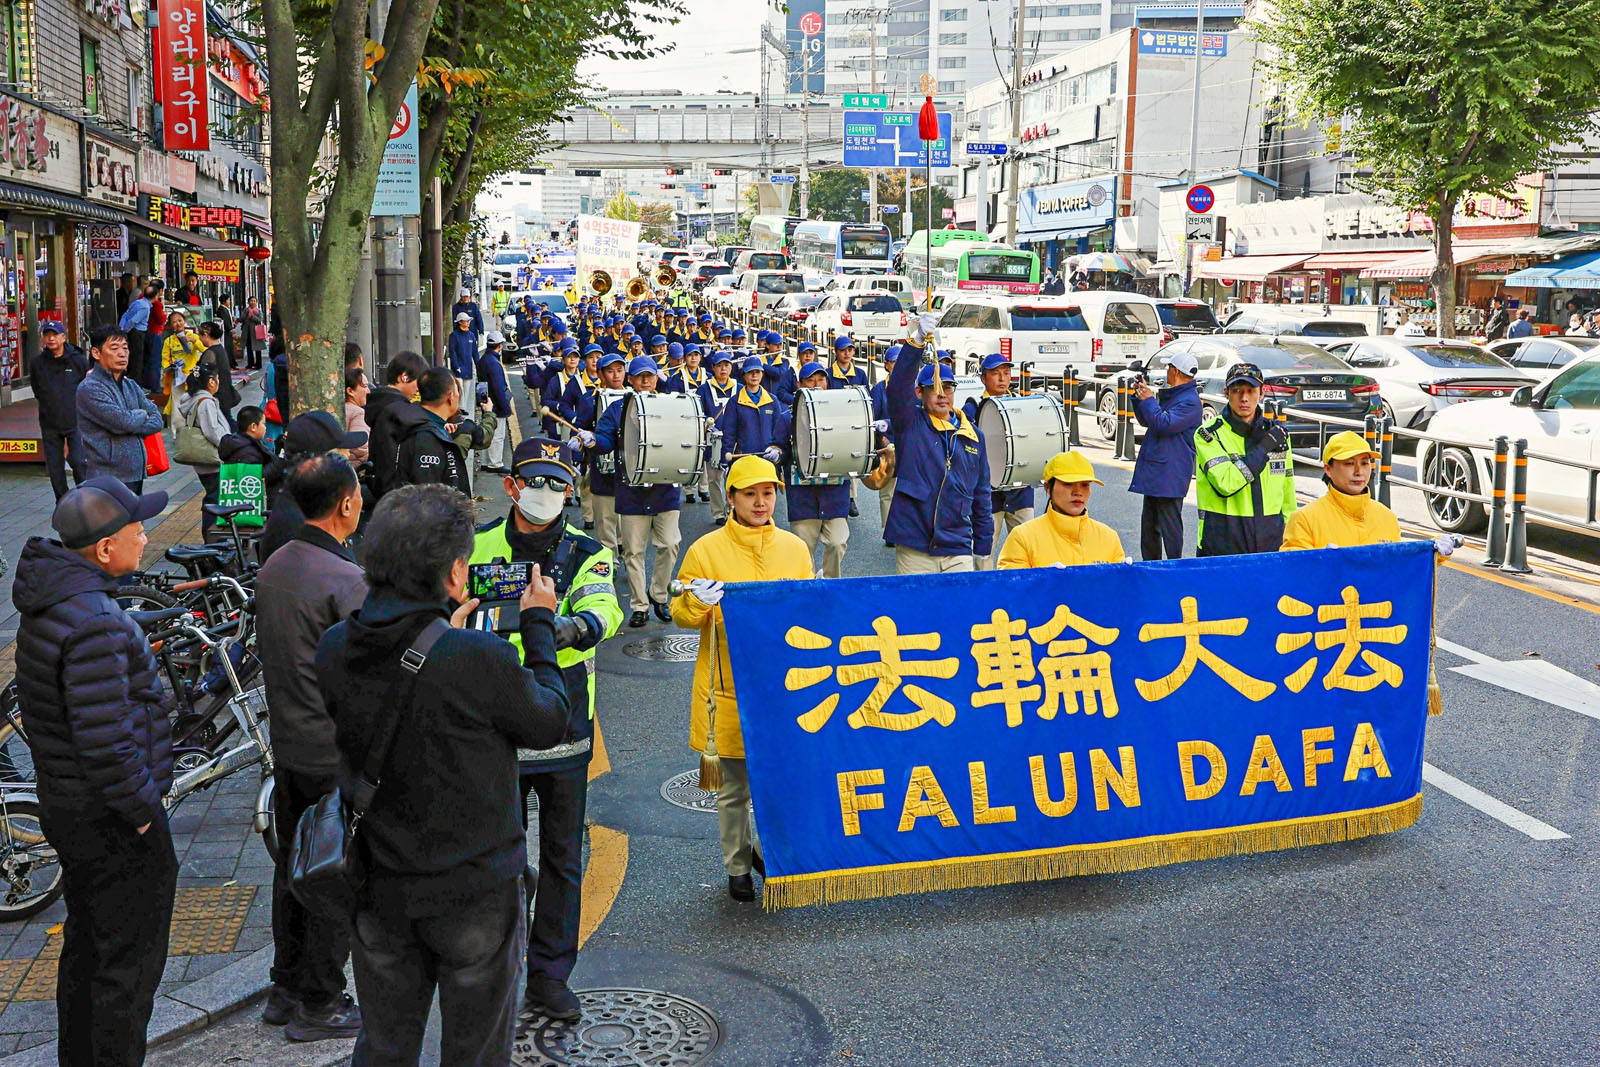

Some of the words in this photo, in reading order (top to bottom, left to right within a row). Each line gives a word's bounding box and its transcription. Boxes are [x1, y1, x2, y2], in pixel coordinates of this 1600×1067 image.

[802, 39, 820, 52] LG
[170, 8, 200, 144] 양다리구이
[851, 97, 880, 106] 대림역
[884, 115, 911, 124] 남구로역
[846, 137, 876, 145] 도림천로
[189, 207, 242, 226] 코리아
[583, 220, 632, 238] 4억5천만
[93, 240, 120, 249] 24시
[90, 250, 121, 259] 입큰오리
[1008, 266, 1025, 275] 6511
[1324, 391, 1343, 399] 6874
[220, 479, 238, 495] RE:
[784, 585, 1409, 733] 法輪大法
[837, 745, 1143, 836] FALUN
[1177, 722, 1393, 802] DAFA
